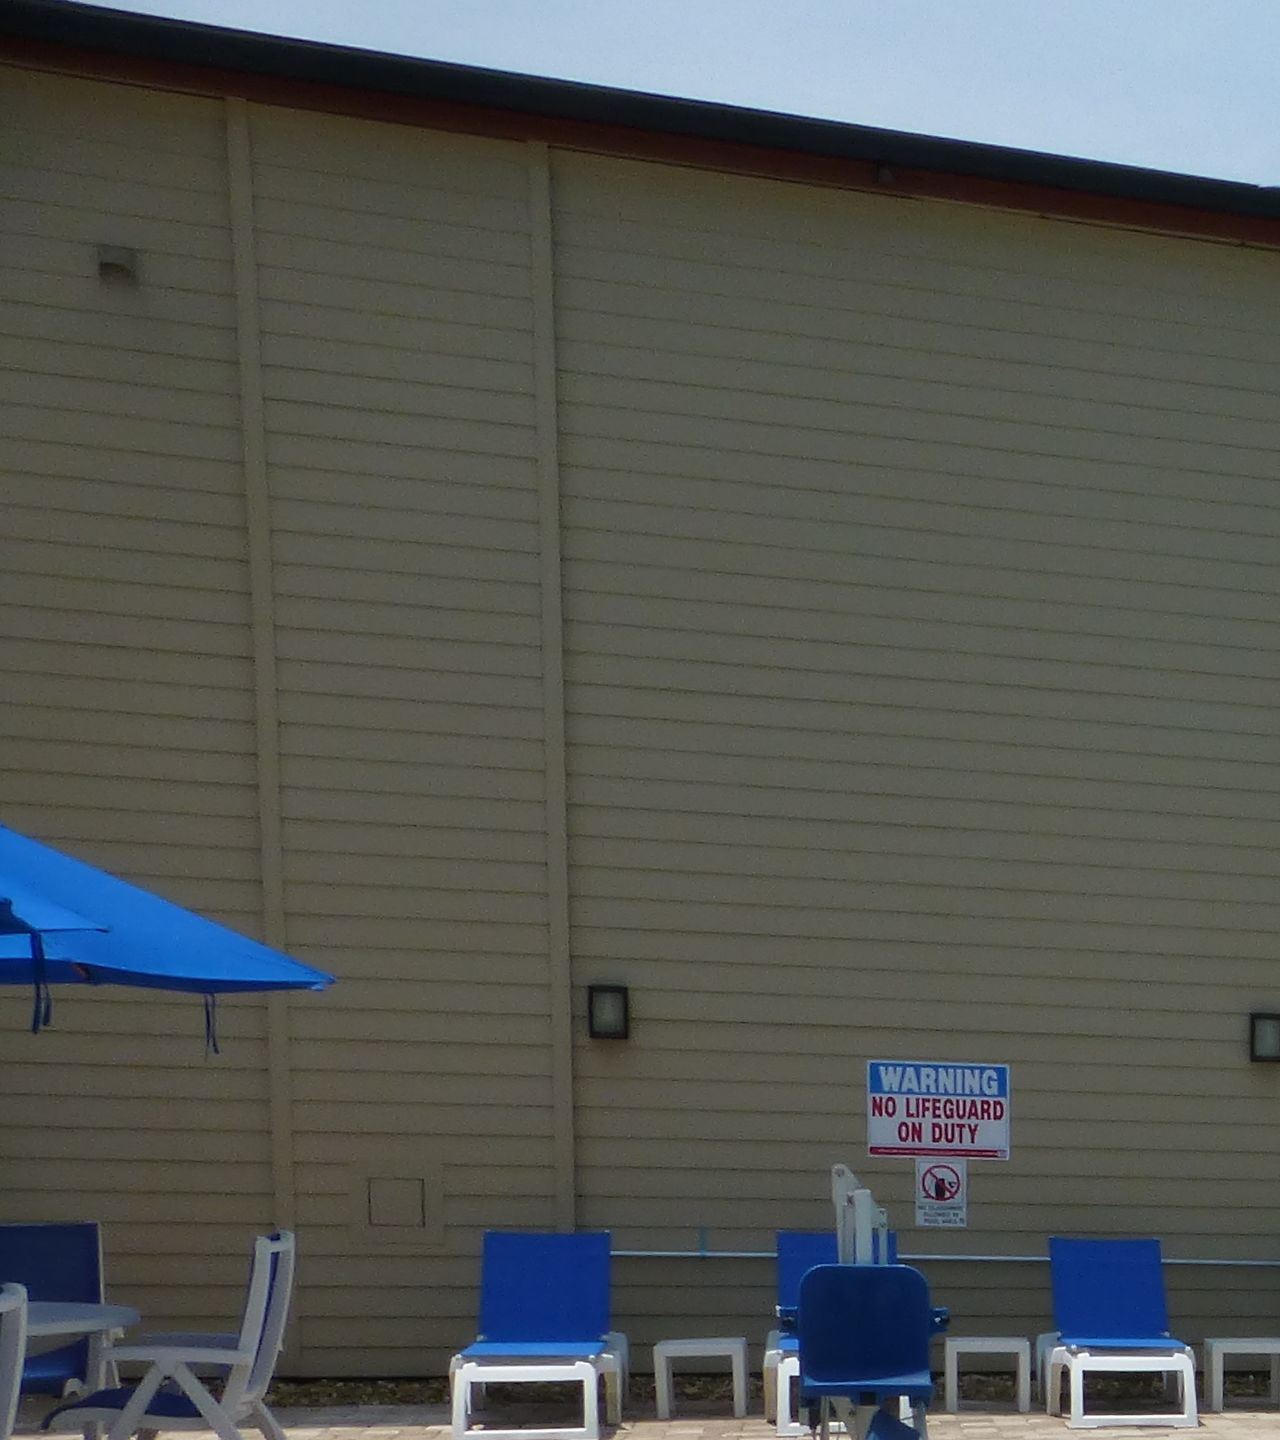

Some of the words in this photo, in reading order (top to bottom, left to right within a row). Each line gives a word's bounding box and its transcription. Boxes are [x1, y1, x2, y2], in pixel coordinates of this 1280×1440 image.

[879, 1065, 999, 1096] WARNING
[871, 1096, 897, 1118] NO
[906, 1097, 1005, 1121] LIFEGUARD
[898, 1121, 922, 1143] ON
[931, 1122, 979, 1144] DUTY
